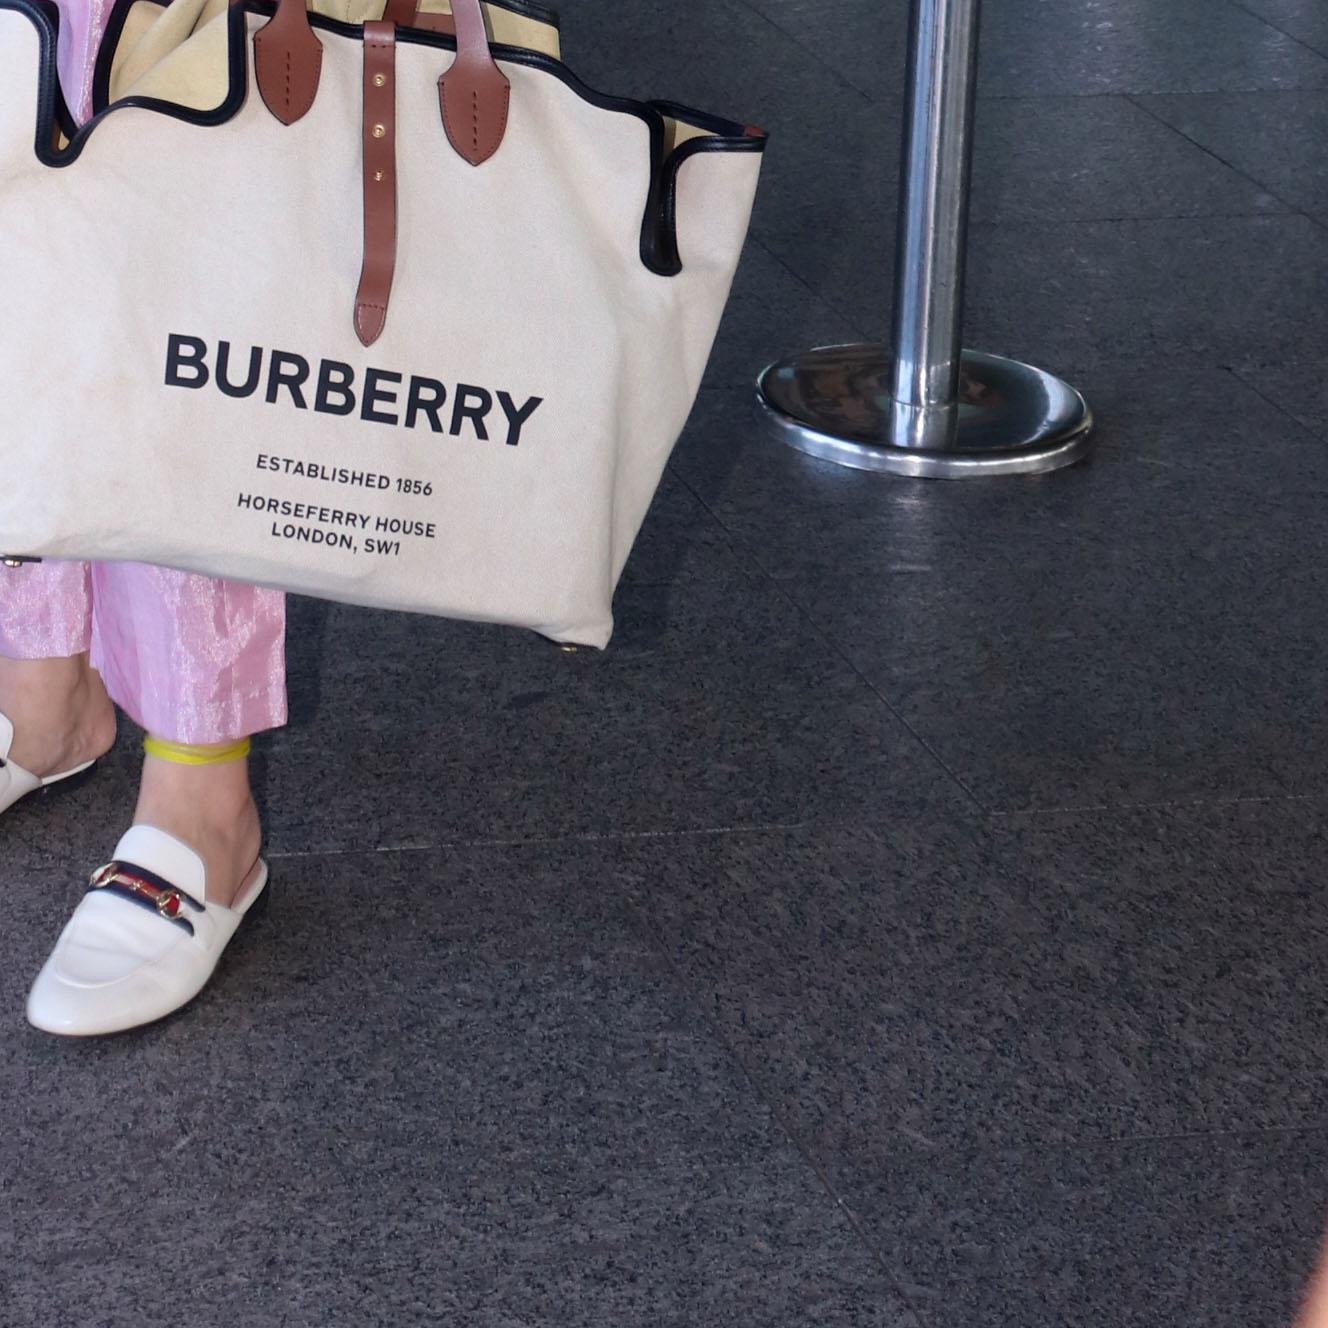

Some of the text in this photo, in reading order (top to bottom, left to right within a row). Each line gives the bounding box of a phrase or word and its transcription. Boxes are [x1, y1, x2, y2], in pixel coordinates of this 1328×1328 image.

[164, 333, 544, 446] BURBERRY
[256, 454, 433, 496] ESTABLISHED 1856
[237, 493, 436, 538] HORSEFERRY HOUSE
[271, 522, 401, 556] LONDON, SW1
